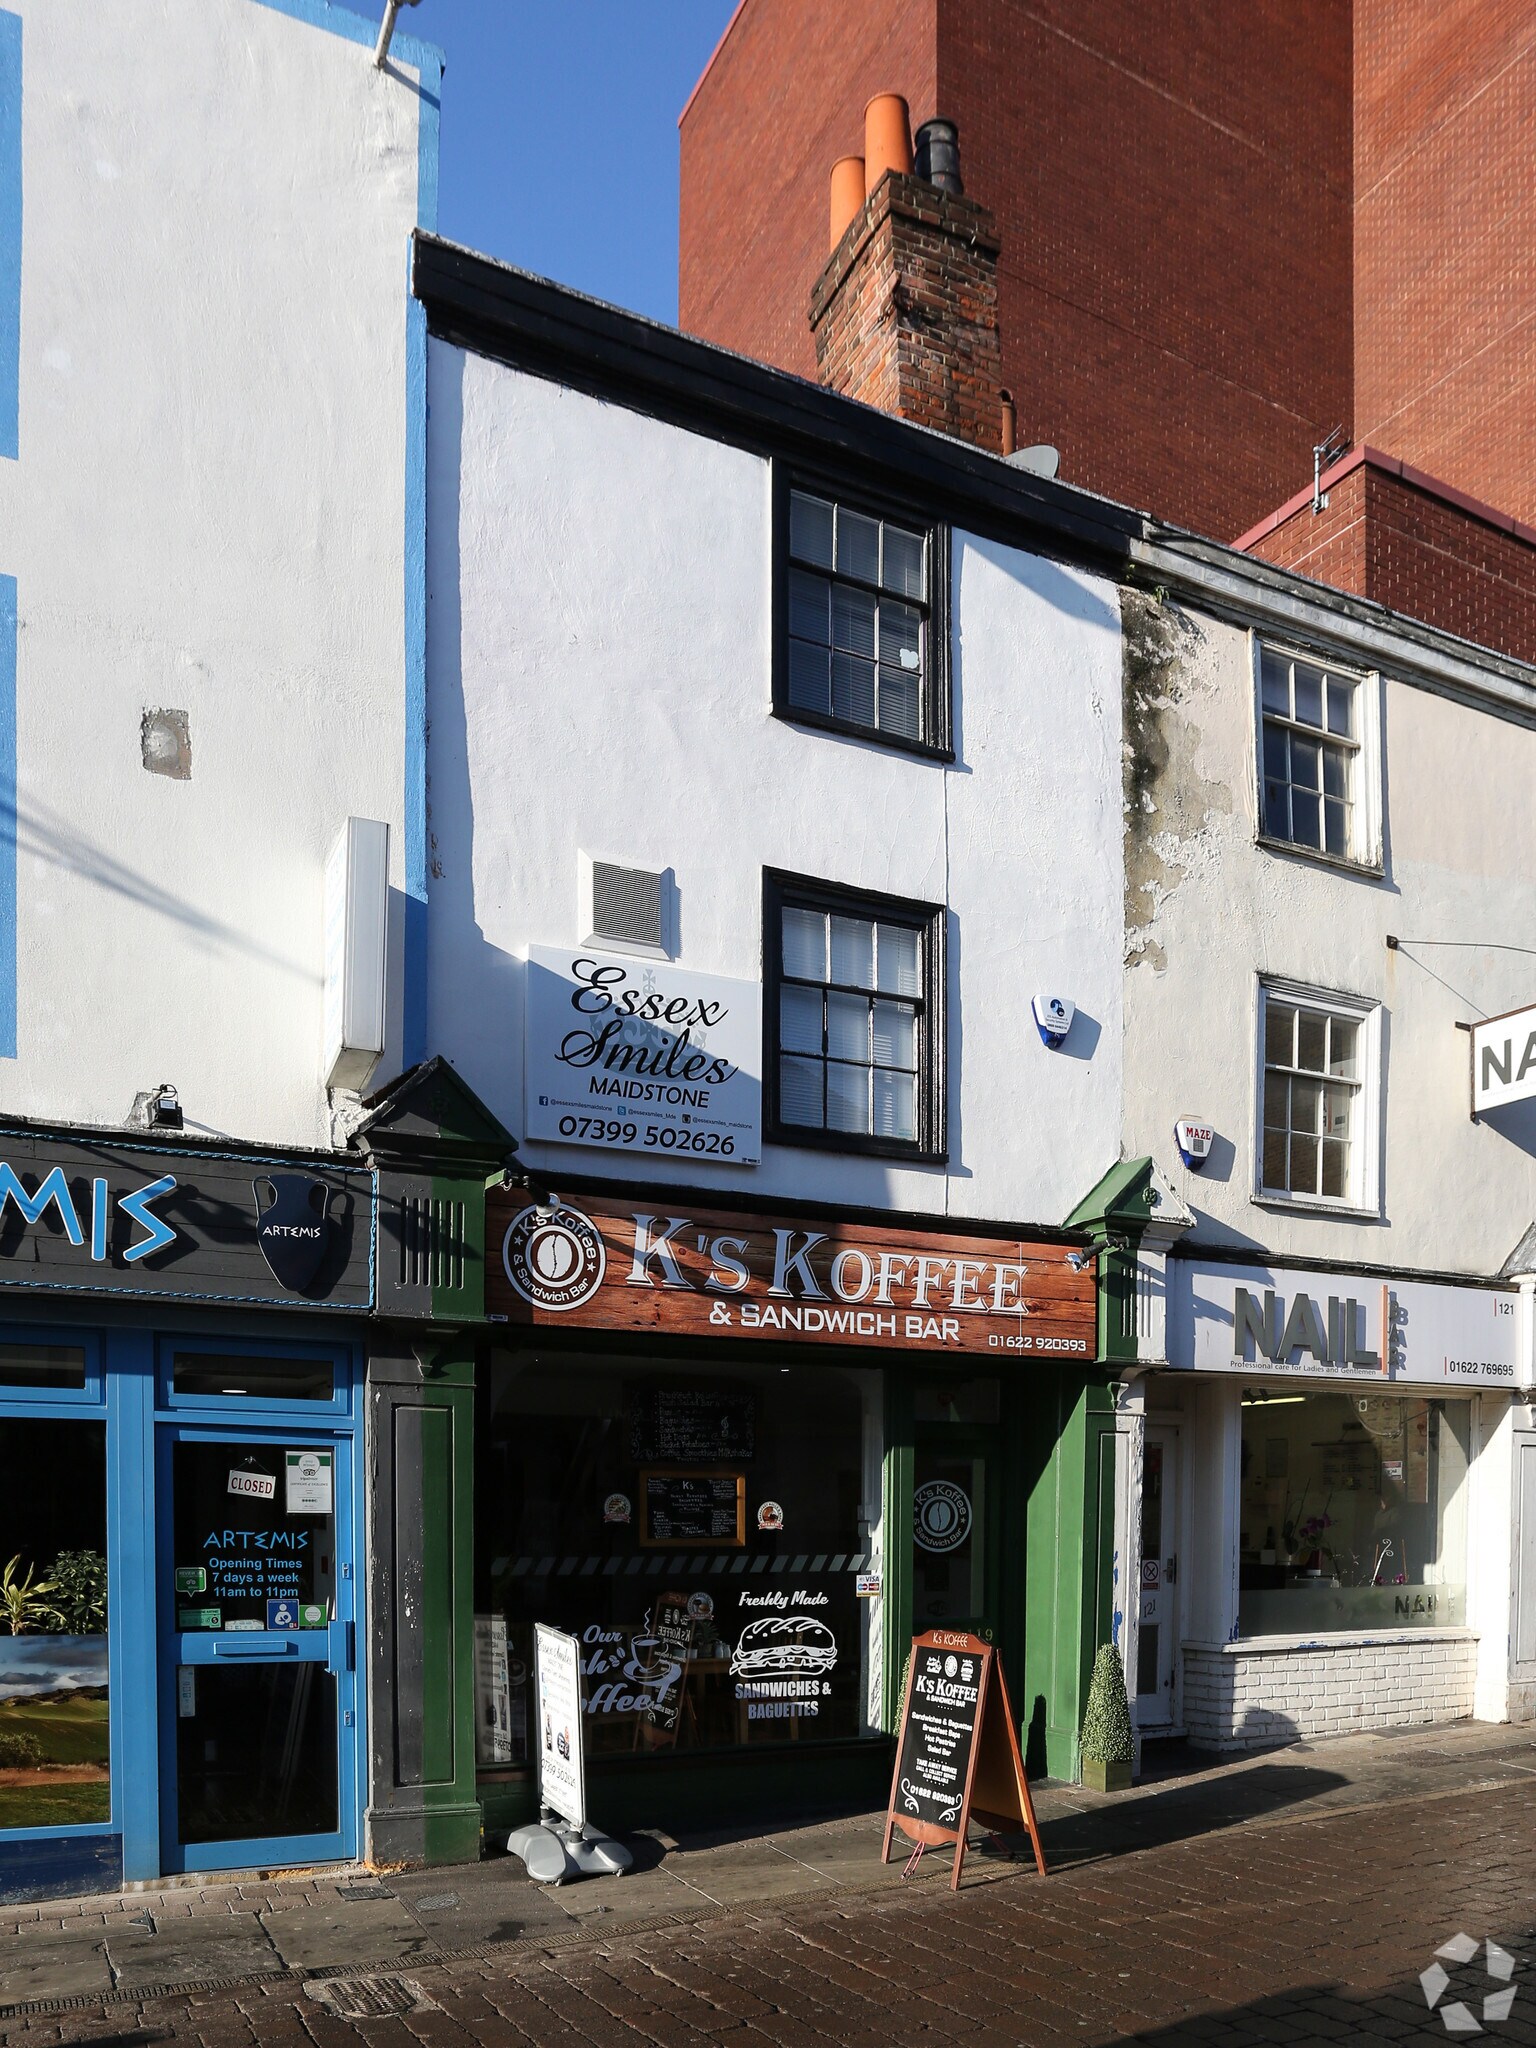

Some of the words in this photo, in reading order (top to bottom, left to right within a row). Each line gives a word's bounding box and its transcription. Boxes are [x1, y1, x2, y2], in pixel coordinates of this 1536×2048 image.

[571, 958, 729, 1027] Essex
[554, 1019, 739, 1084] Smiles
[589, 1076, 710, 1108] MAIDSTONE
[558, 1115, 637, 1143] 07399
[643, 1126, 735, 1155] 502626
[1186, 1126, 1211, 1141] MAZE
[262, 1225, 321, 1239] ARTEMIS
[551, 1211, 597, 1259] Koffee
[513, 1254, 524, 1266] &
[767, 1229, 1029, 1316] KOFFEE
[517, 1268, 570, 1301] Sandwich
[569, 1277, 589, 1298] Bar
[1499, 1303, 1514, 1316] 121
[709, 1301, 732, 1326] &
[740, 1303, 896, 1336] SANDWICH
[905, 1316, 960, 1341] BAR
[1235, 1287, 1378, 1365] NAIL
[989, 1334, 1032, 1349] 01622
[1036, 1337, 1087, 1351] 920393
[1230, 1361, 1273, 1370] Professional
[1303, 1365, 1324, 1373] Ladies
[1340, 1367, 1377, 1376] Gentlemen
[1450, 1361, 1479, 1374] 01622
[1481, 1362, 1514, 1377] 769695
[231, 1477, 273, 1495] CLOSED
[936, 1485, 967, 1515] Koffee
[203, 1530, 309, 1550] ARTEMIS
[916, 1526, 950, 1547] Sandwich
[949, 1528, 962, 1543] Bar
[209, 1558, 262, 1571] Opening
[265, 1558, 303, 1569] Times
[212, 1573, 219, 1583] 7
[223, 1572, 253, 1585] days
[257, 1575, 265, 1583] a
[267, 1572, 299, 1583] week
[213, 1587, 246, 1597] 11am
[249, 1587, 262, 1597] to
[266, 1587, 298, 1600] 11pm
[738, 1591, 789, 1609] Freshly
[791, 1590, 829, 1606] Made
[1144, 1599, 1156, 1618] 121
[583, 1625, 622, 1644] Our
[735, 1681, 820, 1699] SANDWICHES
[821, 1680, 832, 1695] &
[935, 1678, 978, 1702] KOFFEE
[748, 1701, 819, 1720] BAGUETTES
